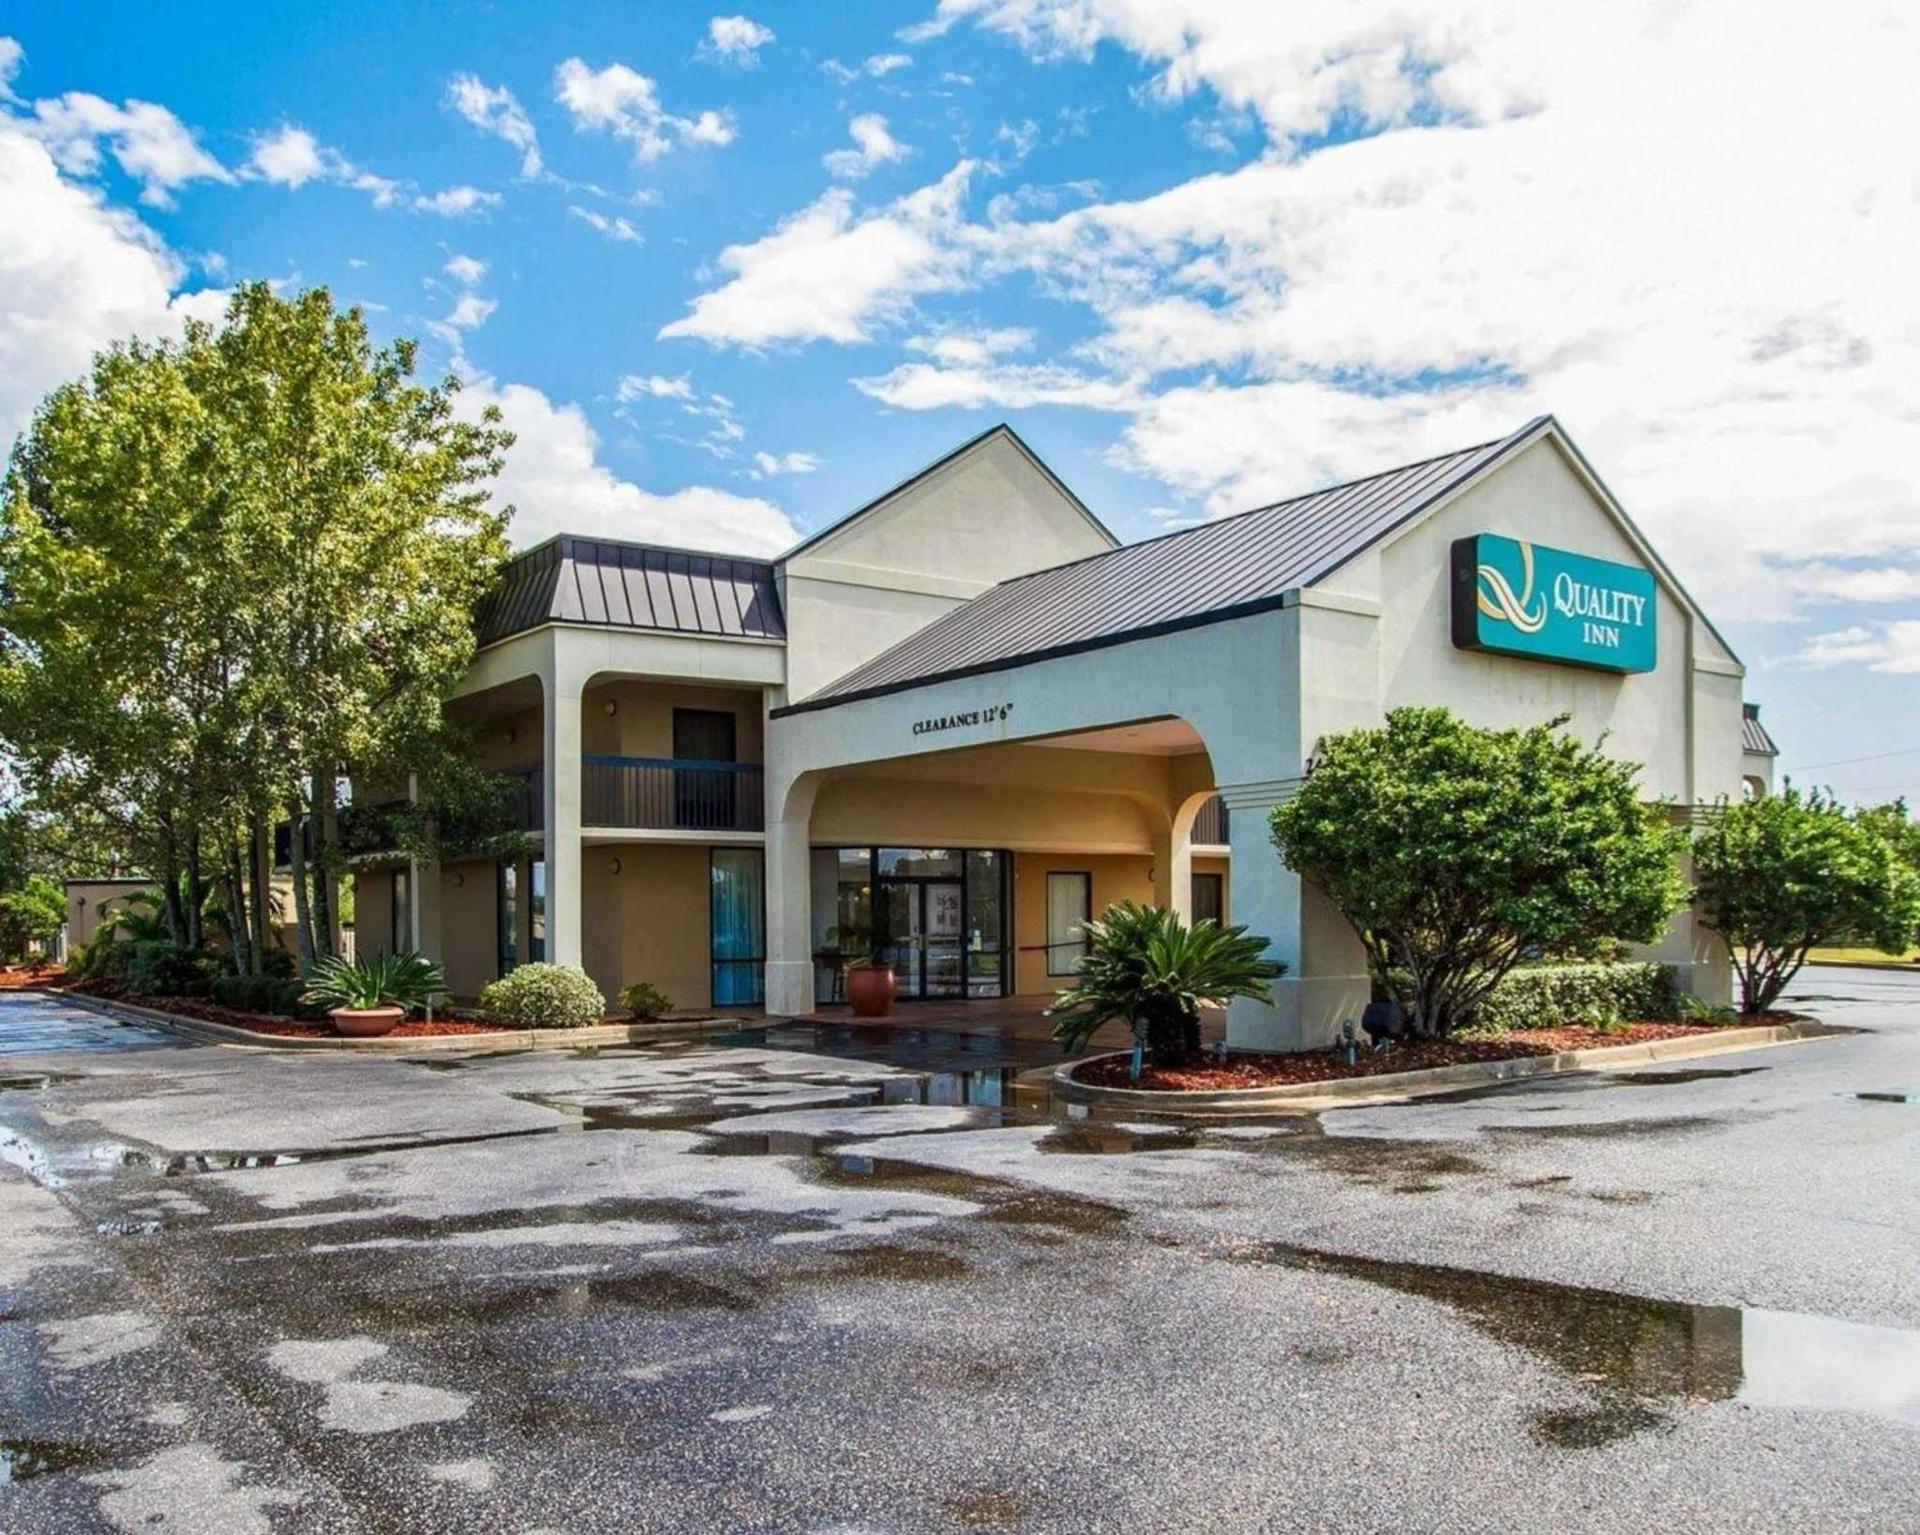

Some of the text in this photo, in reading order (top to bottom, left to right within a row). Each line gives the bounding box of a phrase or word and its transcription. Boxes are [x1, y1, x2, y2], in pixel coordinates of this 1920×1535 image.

[1554, 572, 1645, 626] QUALITY
[1583, 622, 1620, 648] INN
[913, 711, 979, 735] CLEARANCE
